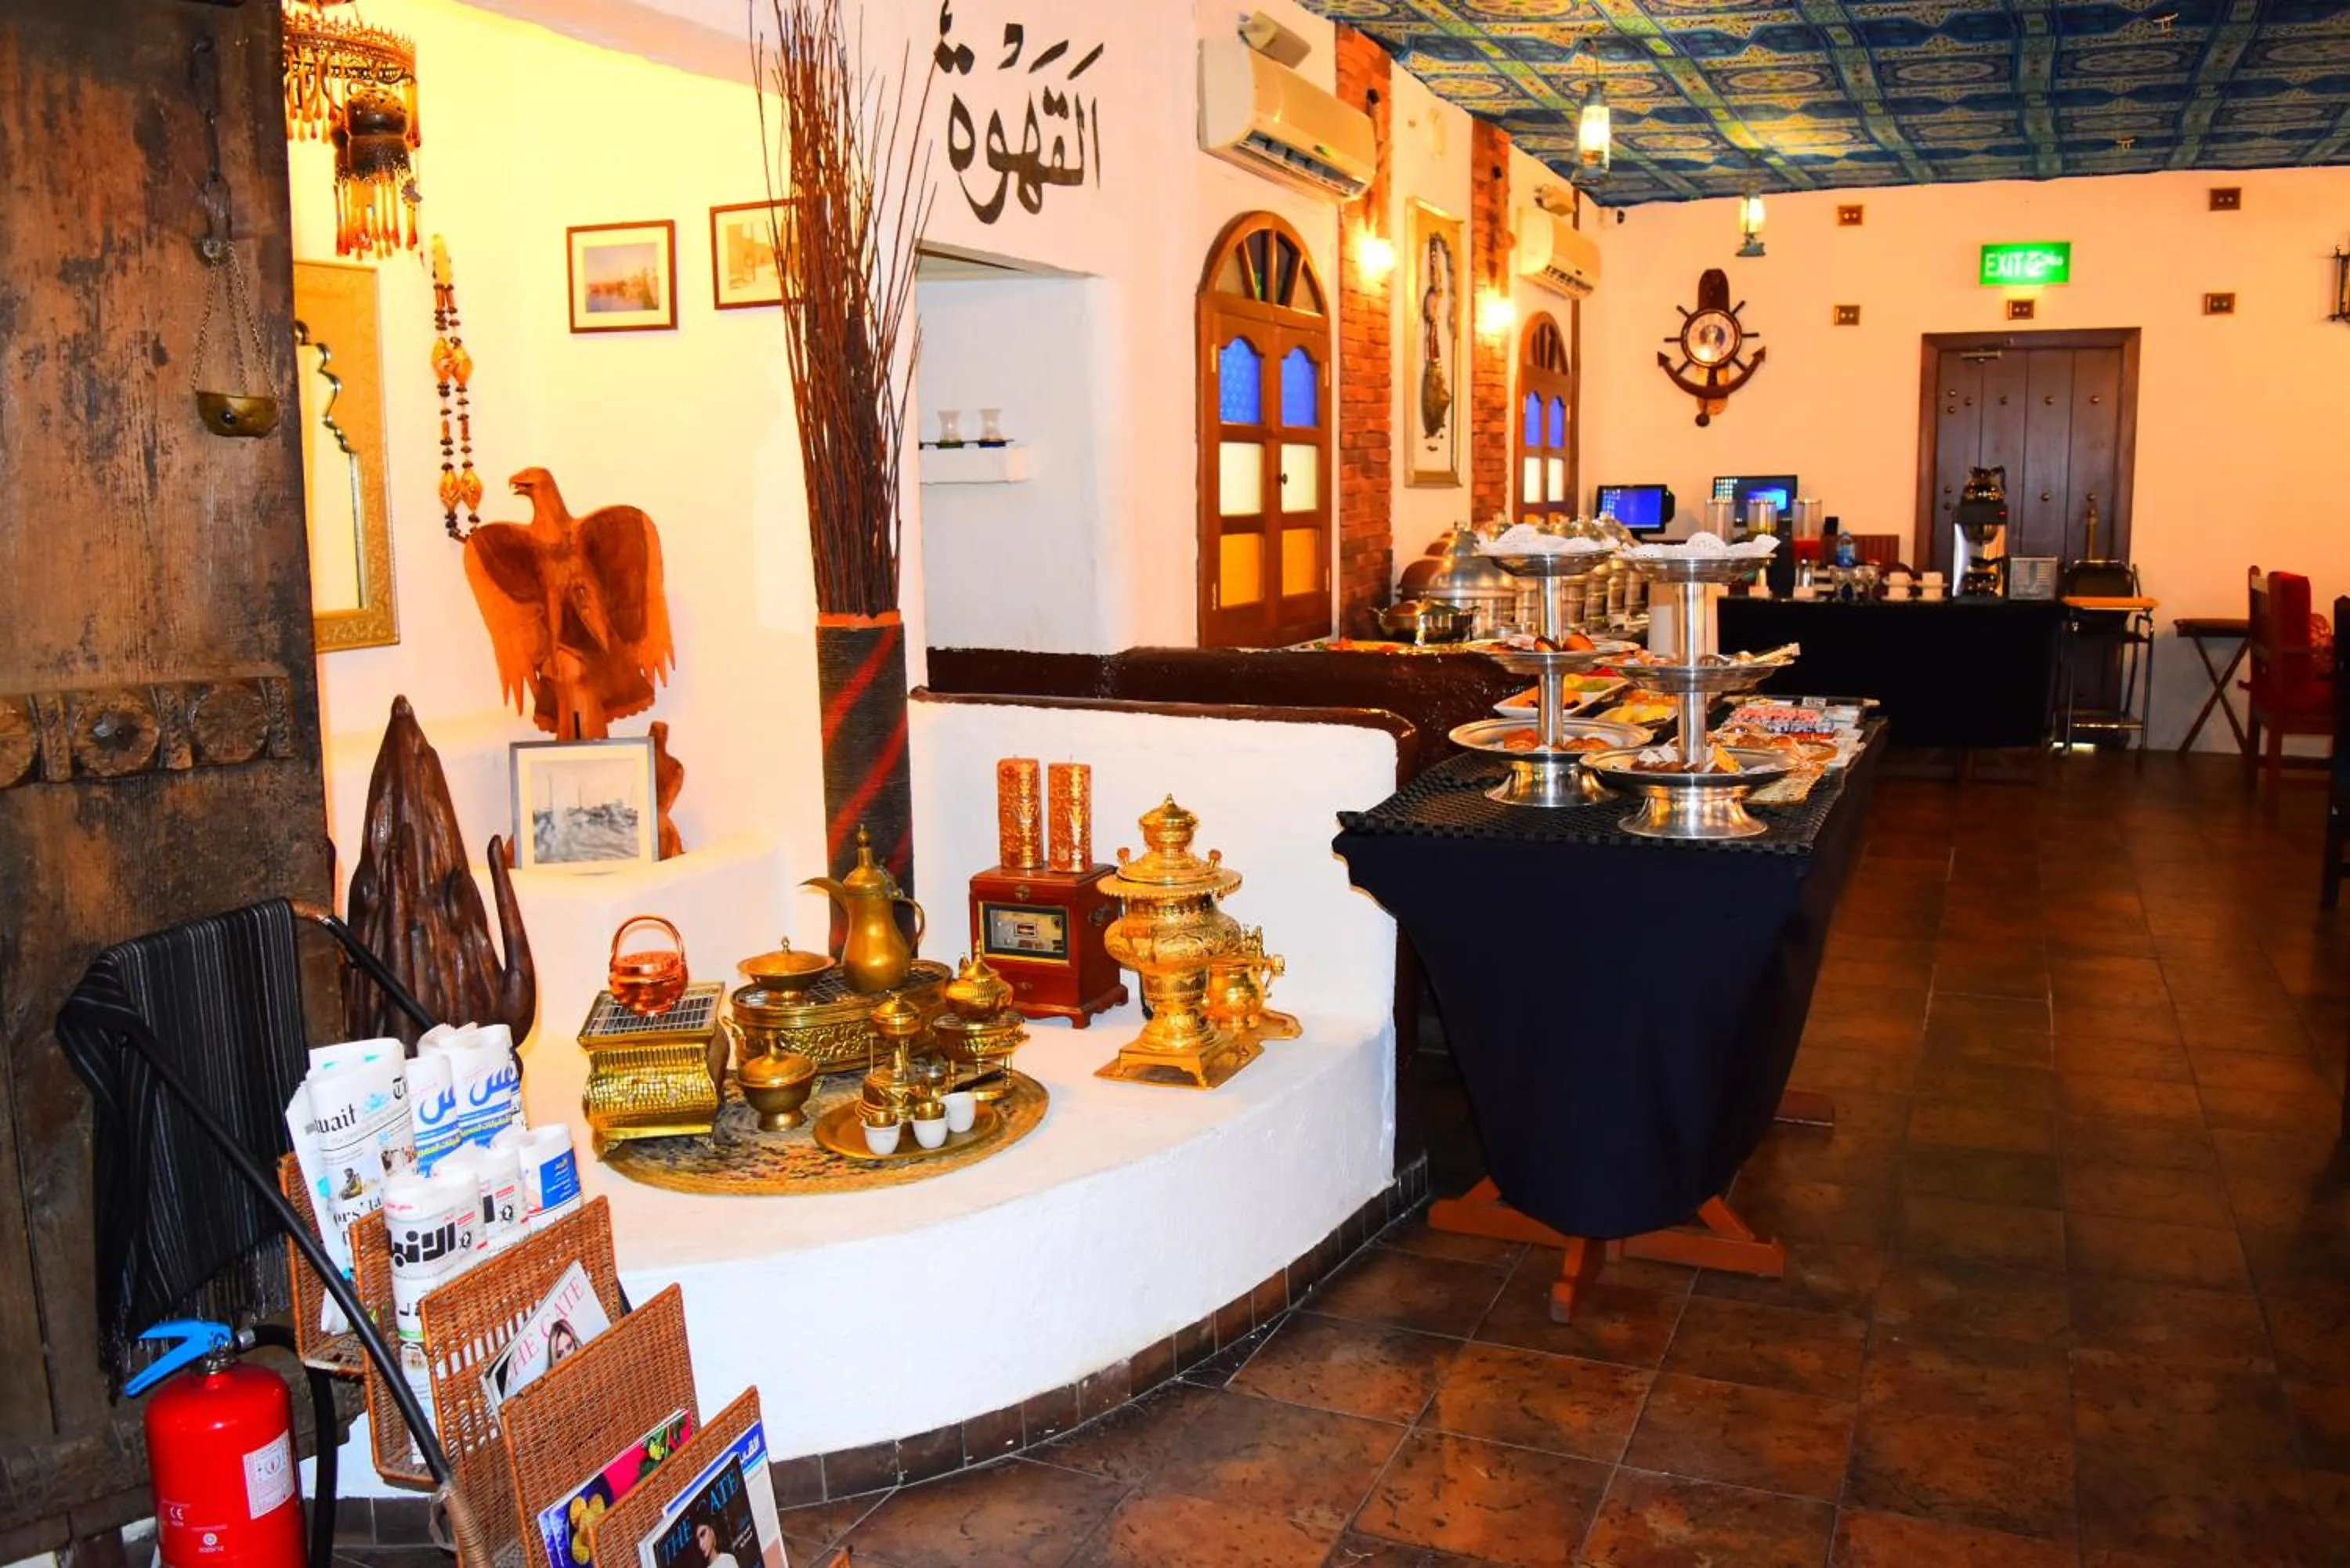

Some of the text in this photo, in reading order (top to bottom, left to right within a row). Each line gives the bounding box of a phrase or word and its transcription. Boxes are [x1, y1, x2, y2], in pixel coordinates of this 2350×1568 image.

[1984, 251, 2024, 276] EXIT
[662, 1468, 739, 1565] THE ATE
